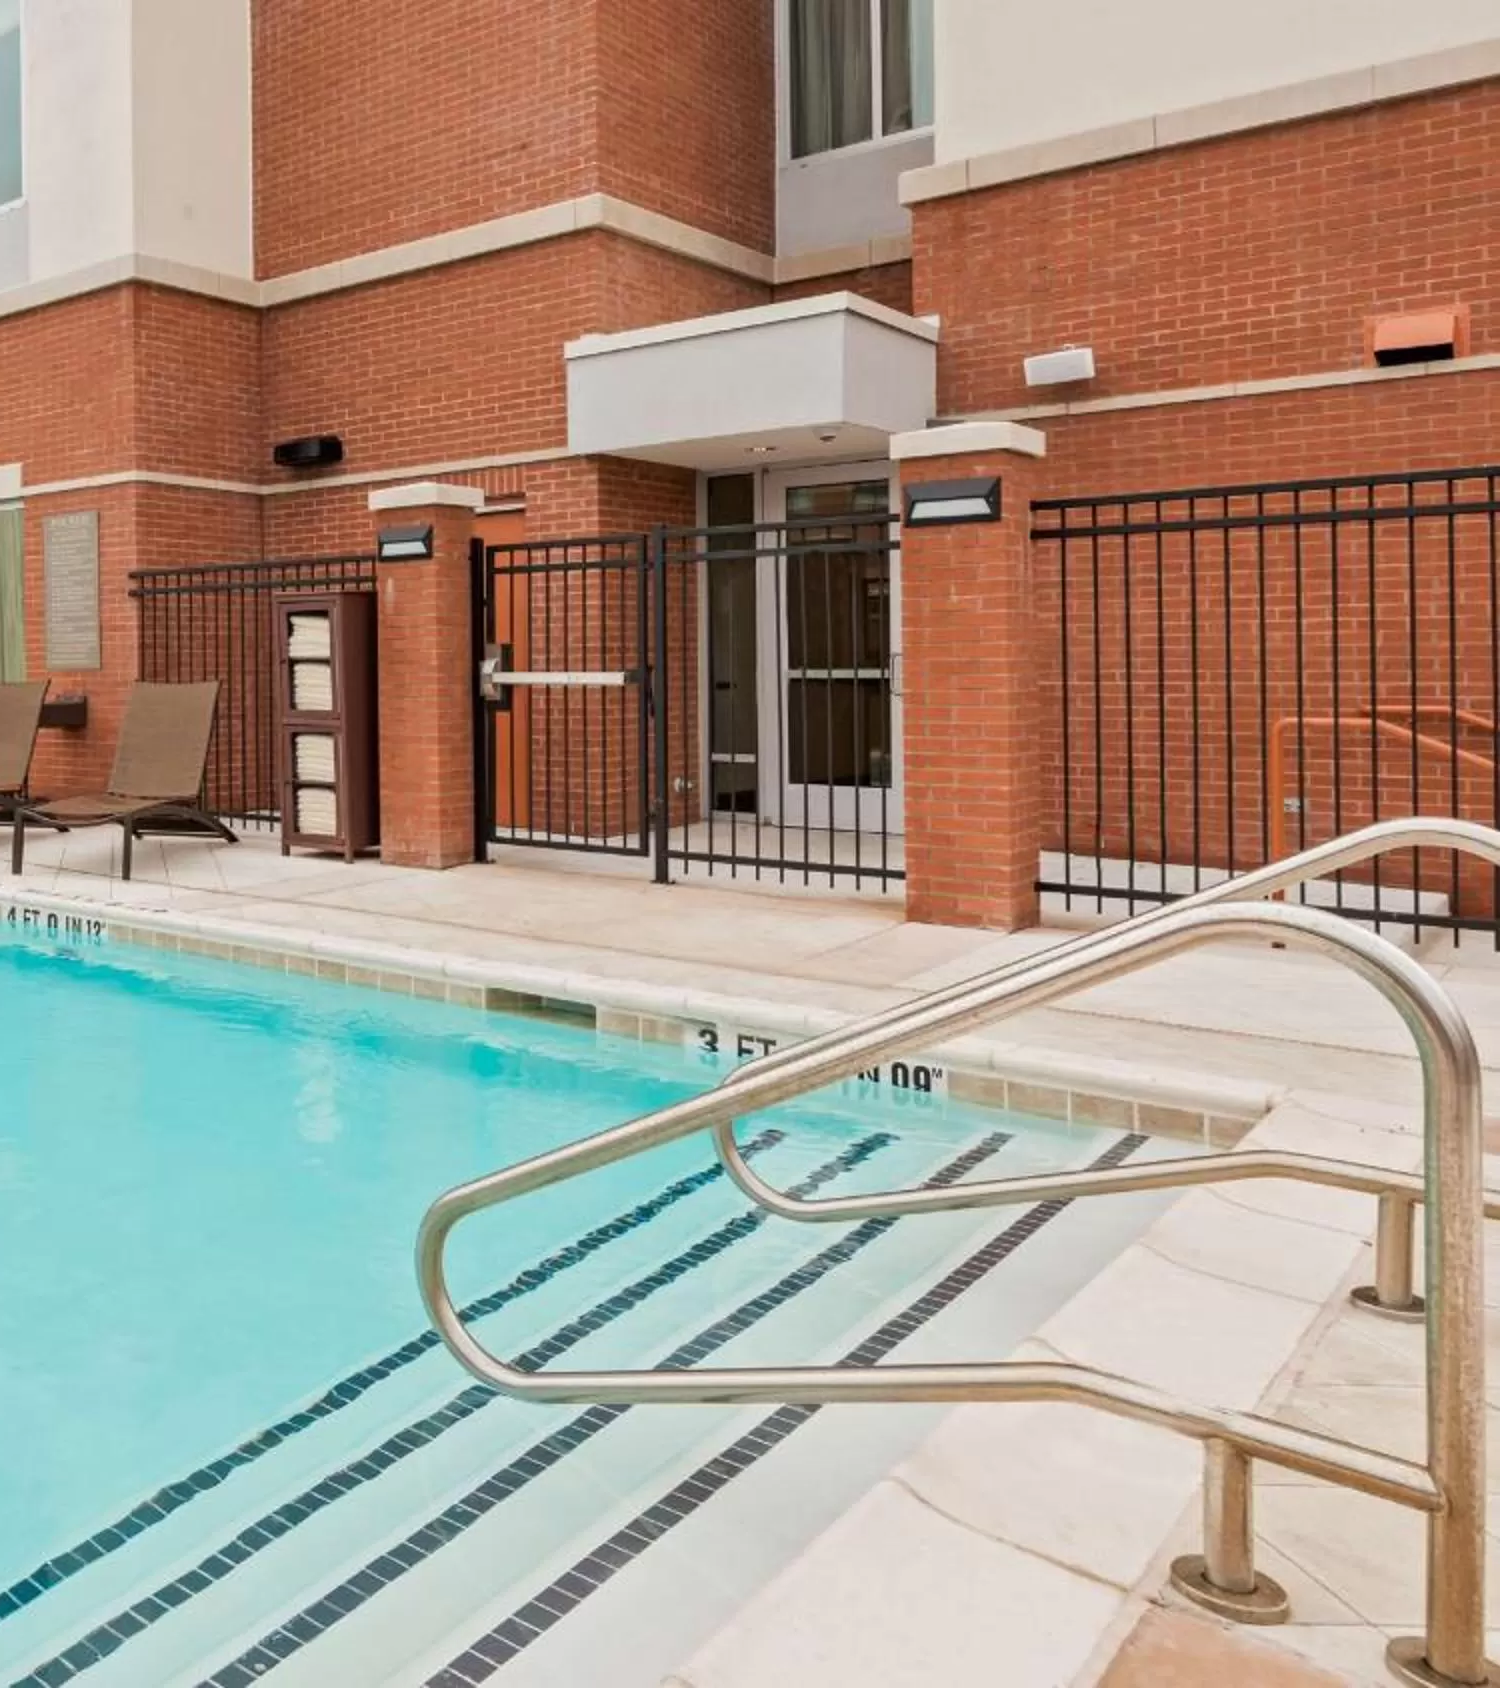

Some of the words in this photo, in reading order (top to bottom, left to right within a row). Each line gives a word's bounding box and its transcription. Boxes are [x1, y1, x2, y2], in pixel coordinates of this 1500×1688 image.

[7, 905, 16, 926] 4
[23, 908, 40, 927] FT
[65, 914, 82, 934] IN
[698, 1028, 718, 1053] 3
[737, 1034, 777, 1057] FT
